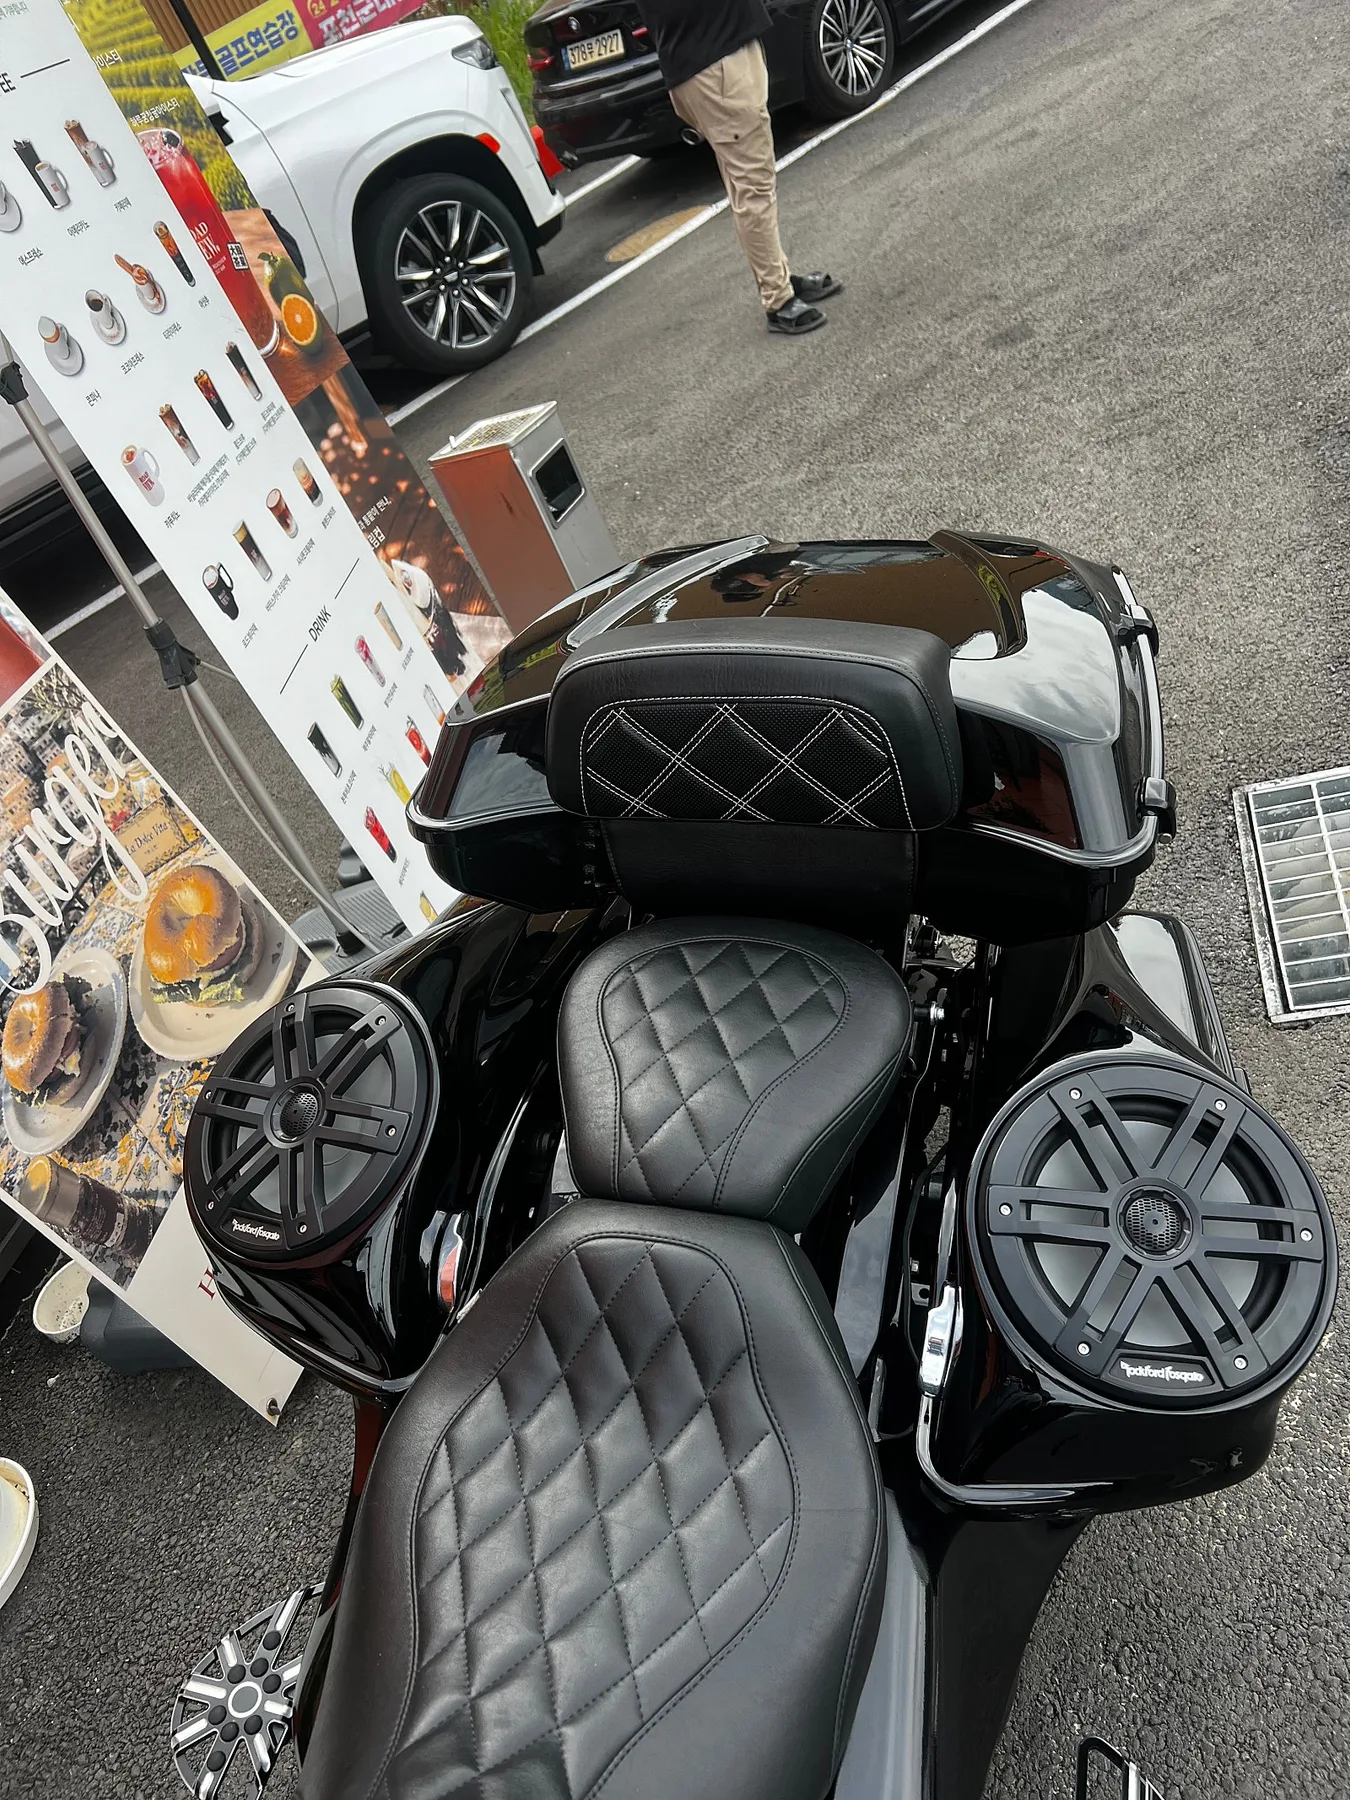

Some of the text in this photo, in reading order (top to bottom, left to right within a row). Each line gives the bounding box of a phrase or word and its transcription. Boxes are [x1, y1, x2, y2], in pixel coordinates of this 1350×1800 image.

[214, 10, 299, 77] 골프연습장
[595, 32, 620, 56] 2927
[18, 247, 43, 266] 에스프레소
[308, 605, 332, 642] DRINK
